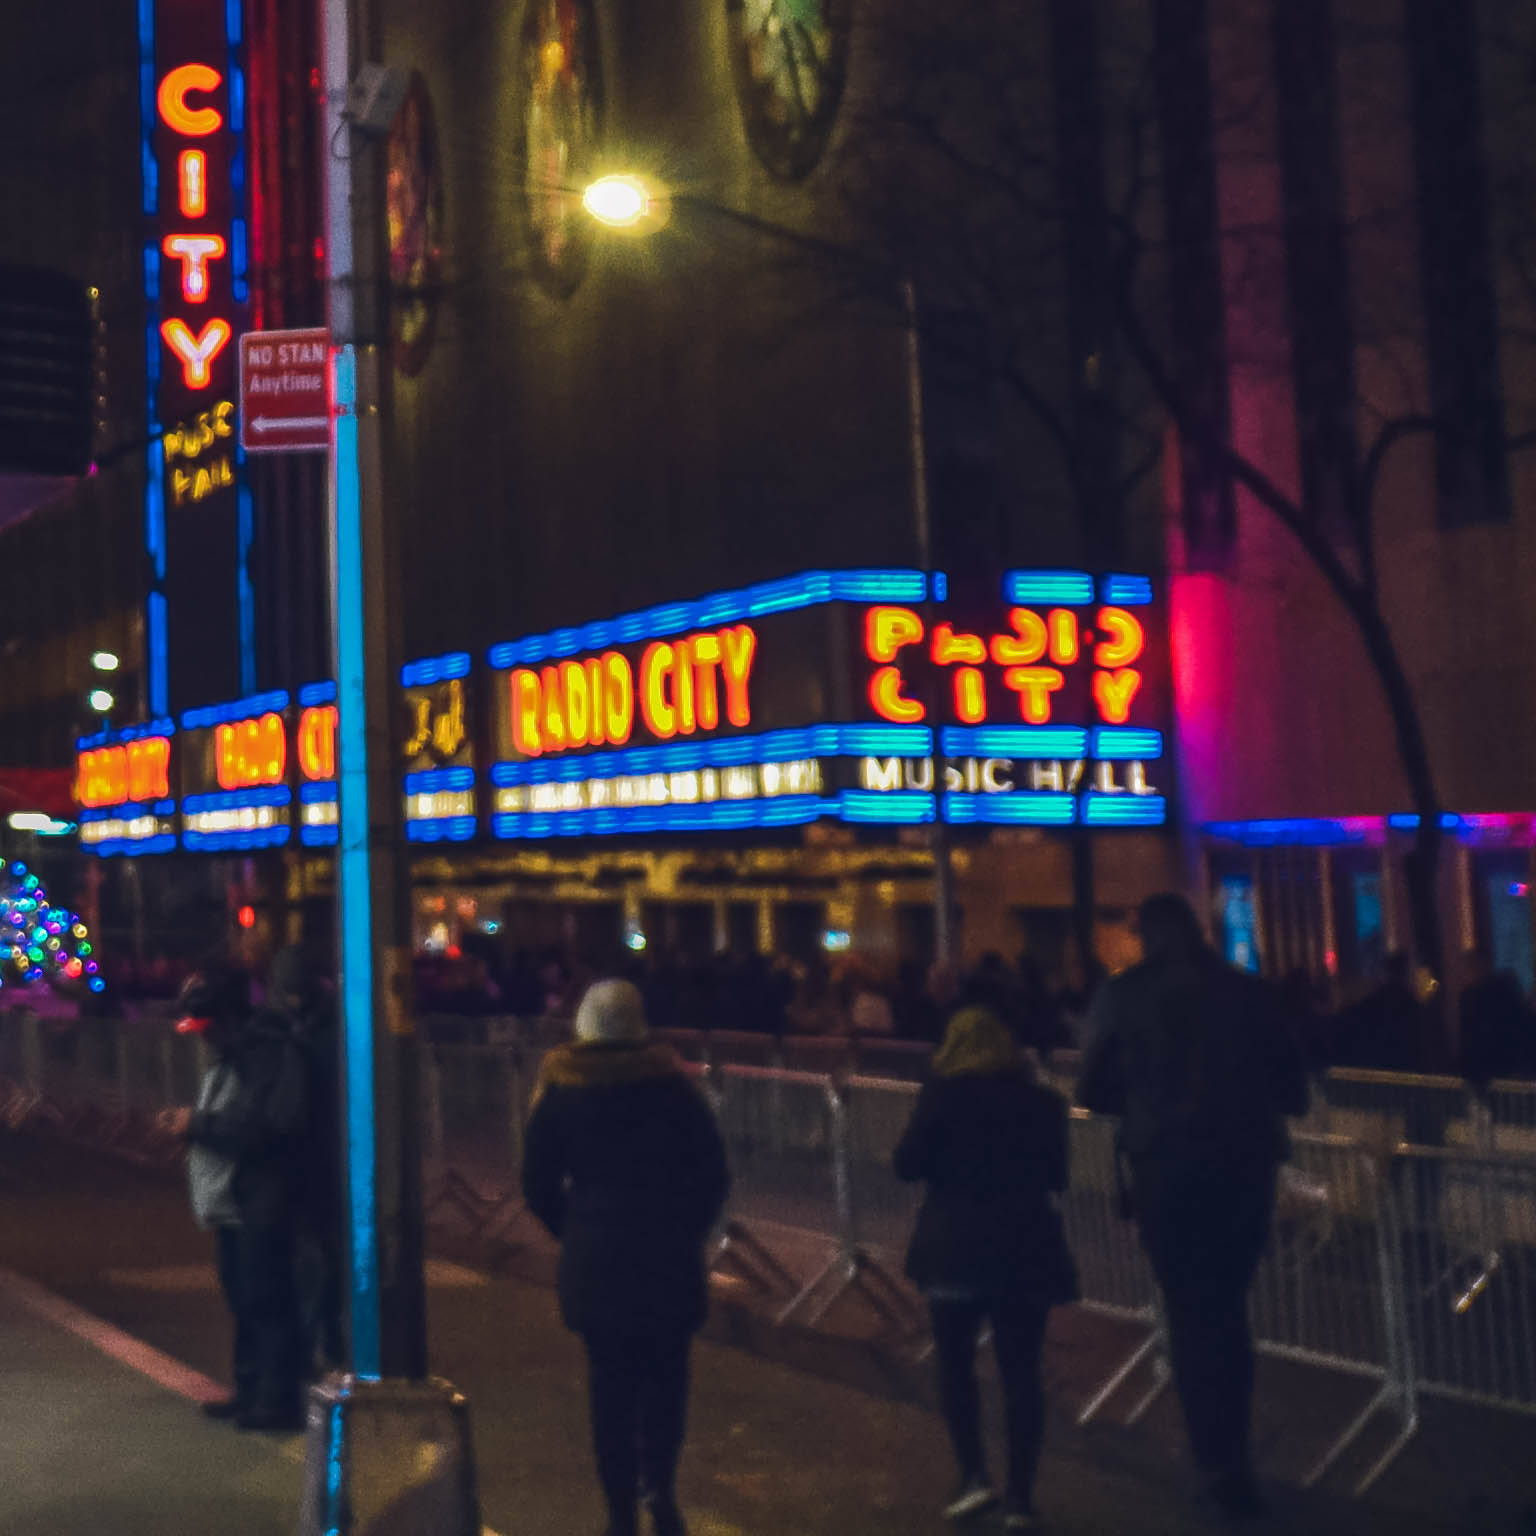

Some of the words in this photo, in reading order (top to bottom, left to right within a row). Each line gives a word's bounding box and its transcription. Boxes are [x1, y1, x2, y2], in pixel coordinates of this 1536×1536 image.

[156, 62, 232, 390] CITY
[247, 344, 272, 366] NO
[249, 371, 322, 396] Anytime
[639, 624, 757, 739] CITY
